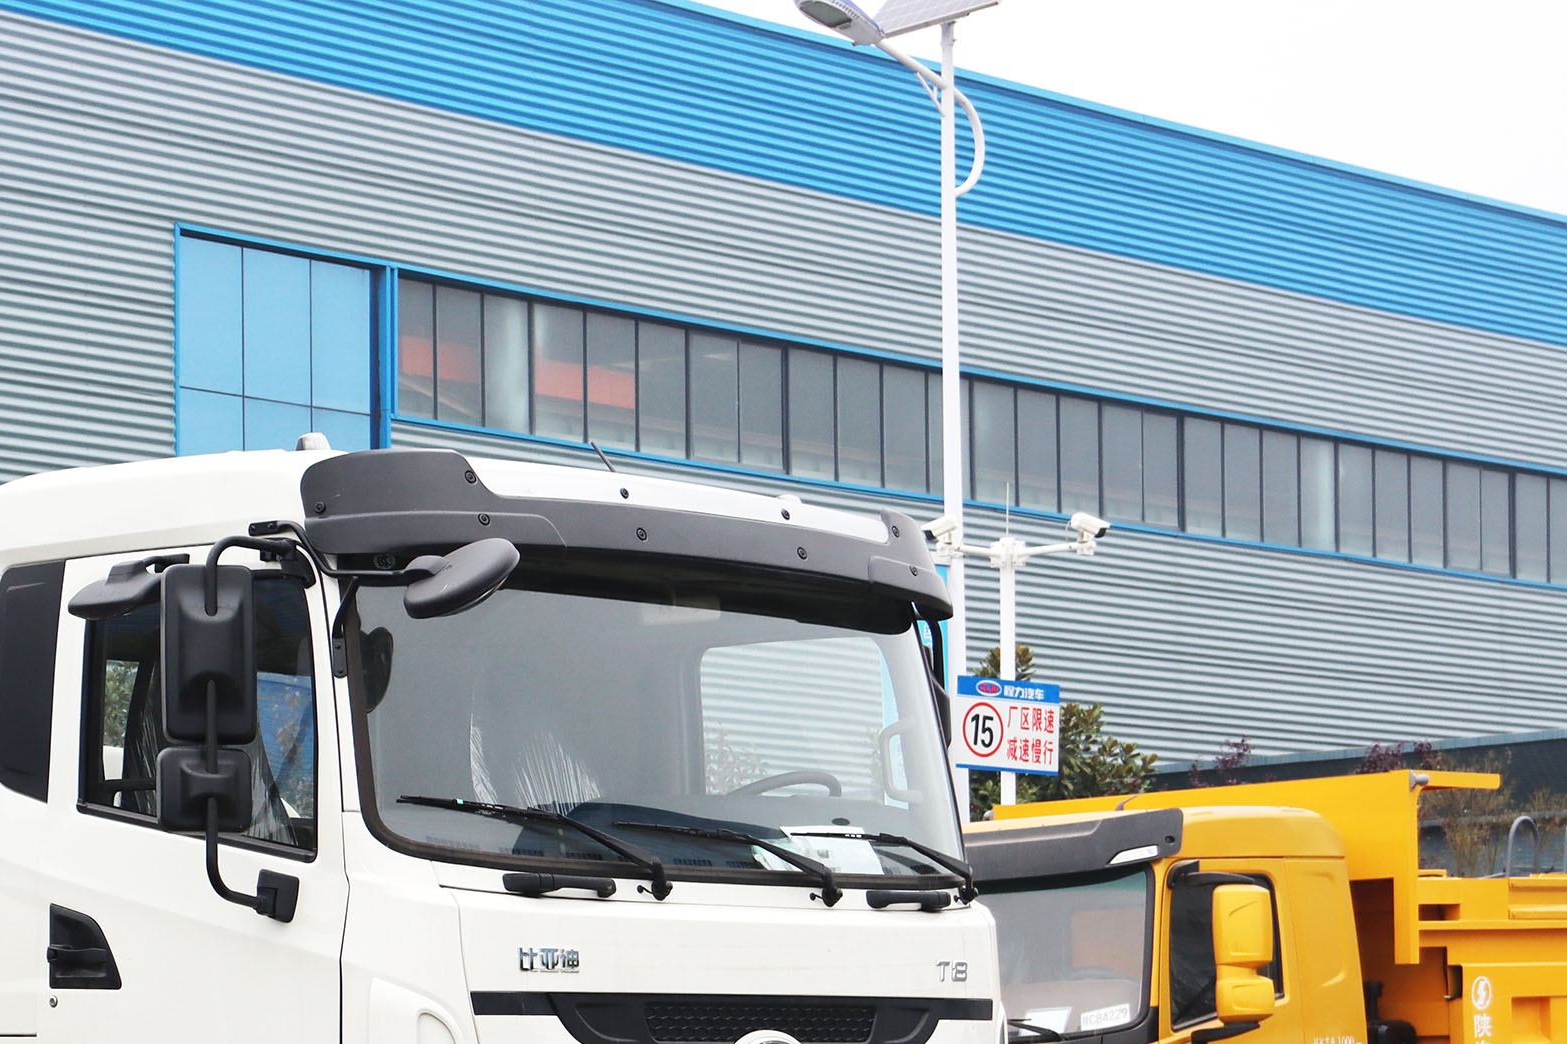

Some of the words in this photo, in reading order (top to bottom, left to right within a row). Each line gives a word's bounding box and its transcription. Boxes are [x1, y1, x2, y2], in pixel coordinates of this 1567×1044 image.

[970, 713, 994, 748] 15
[1007, 706, 1055, 734] 厂区限速
[1007, 736, 1054, 766] 减速慢行
[936, 960, 968, 983] T8
